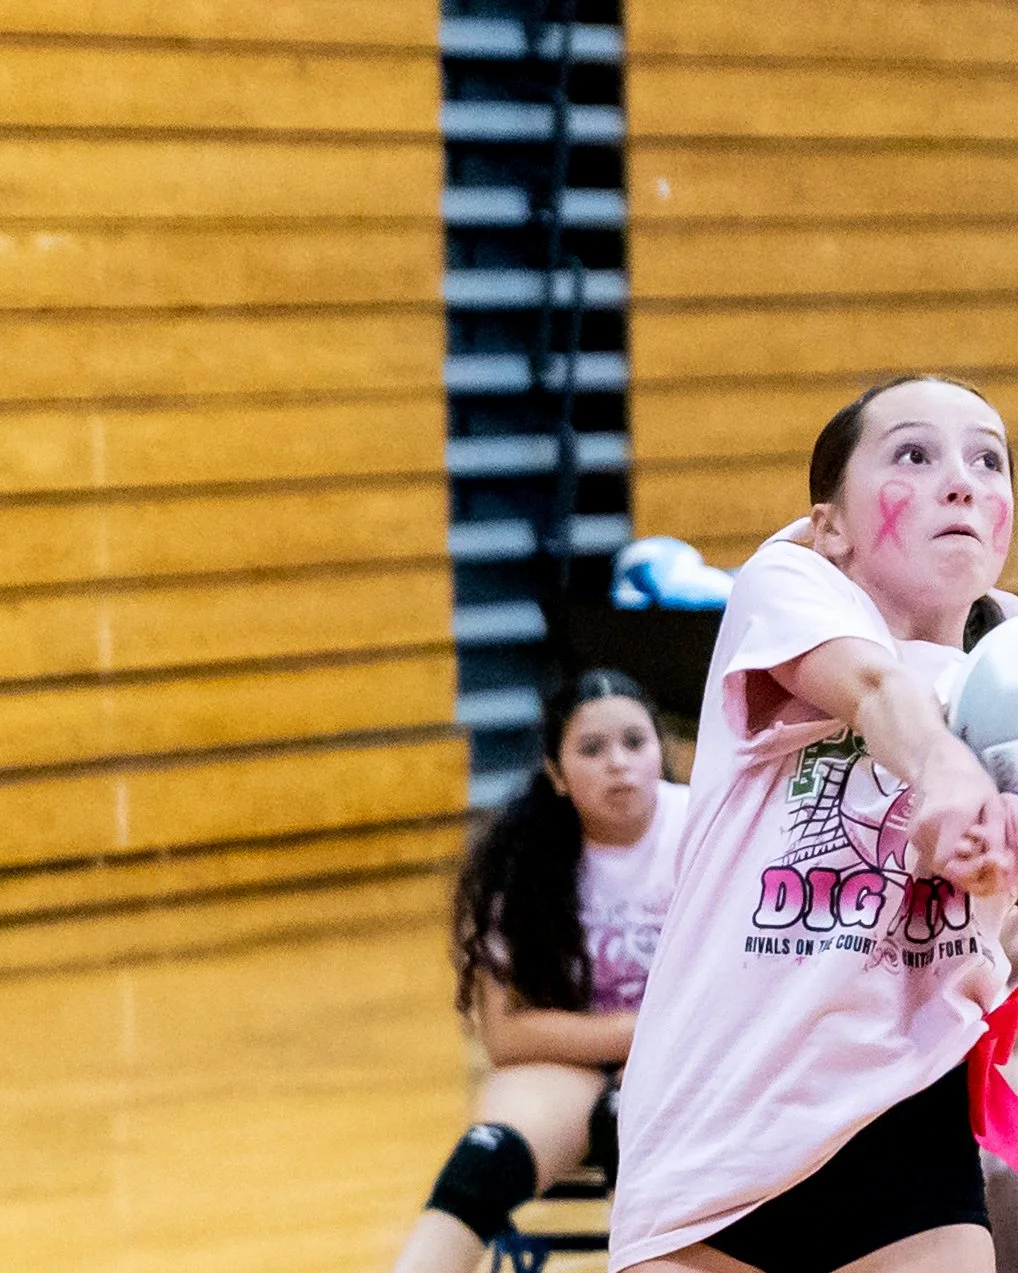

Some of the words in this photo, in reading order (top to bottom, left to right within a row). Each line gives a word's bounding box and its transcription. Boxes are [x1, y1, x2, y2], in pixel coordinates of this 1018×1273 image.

[752, 866, 886, 932] DIG
[744, 936, 791, 955] RIVALS
[796, 939, 814, 955] ON
[836, 934, 877, 955] COURT
[939, 939, 963, 959] FOR
[969, 937, 978, 954] A
